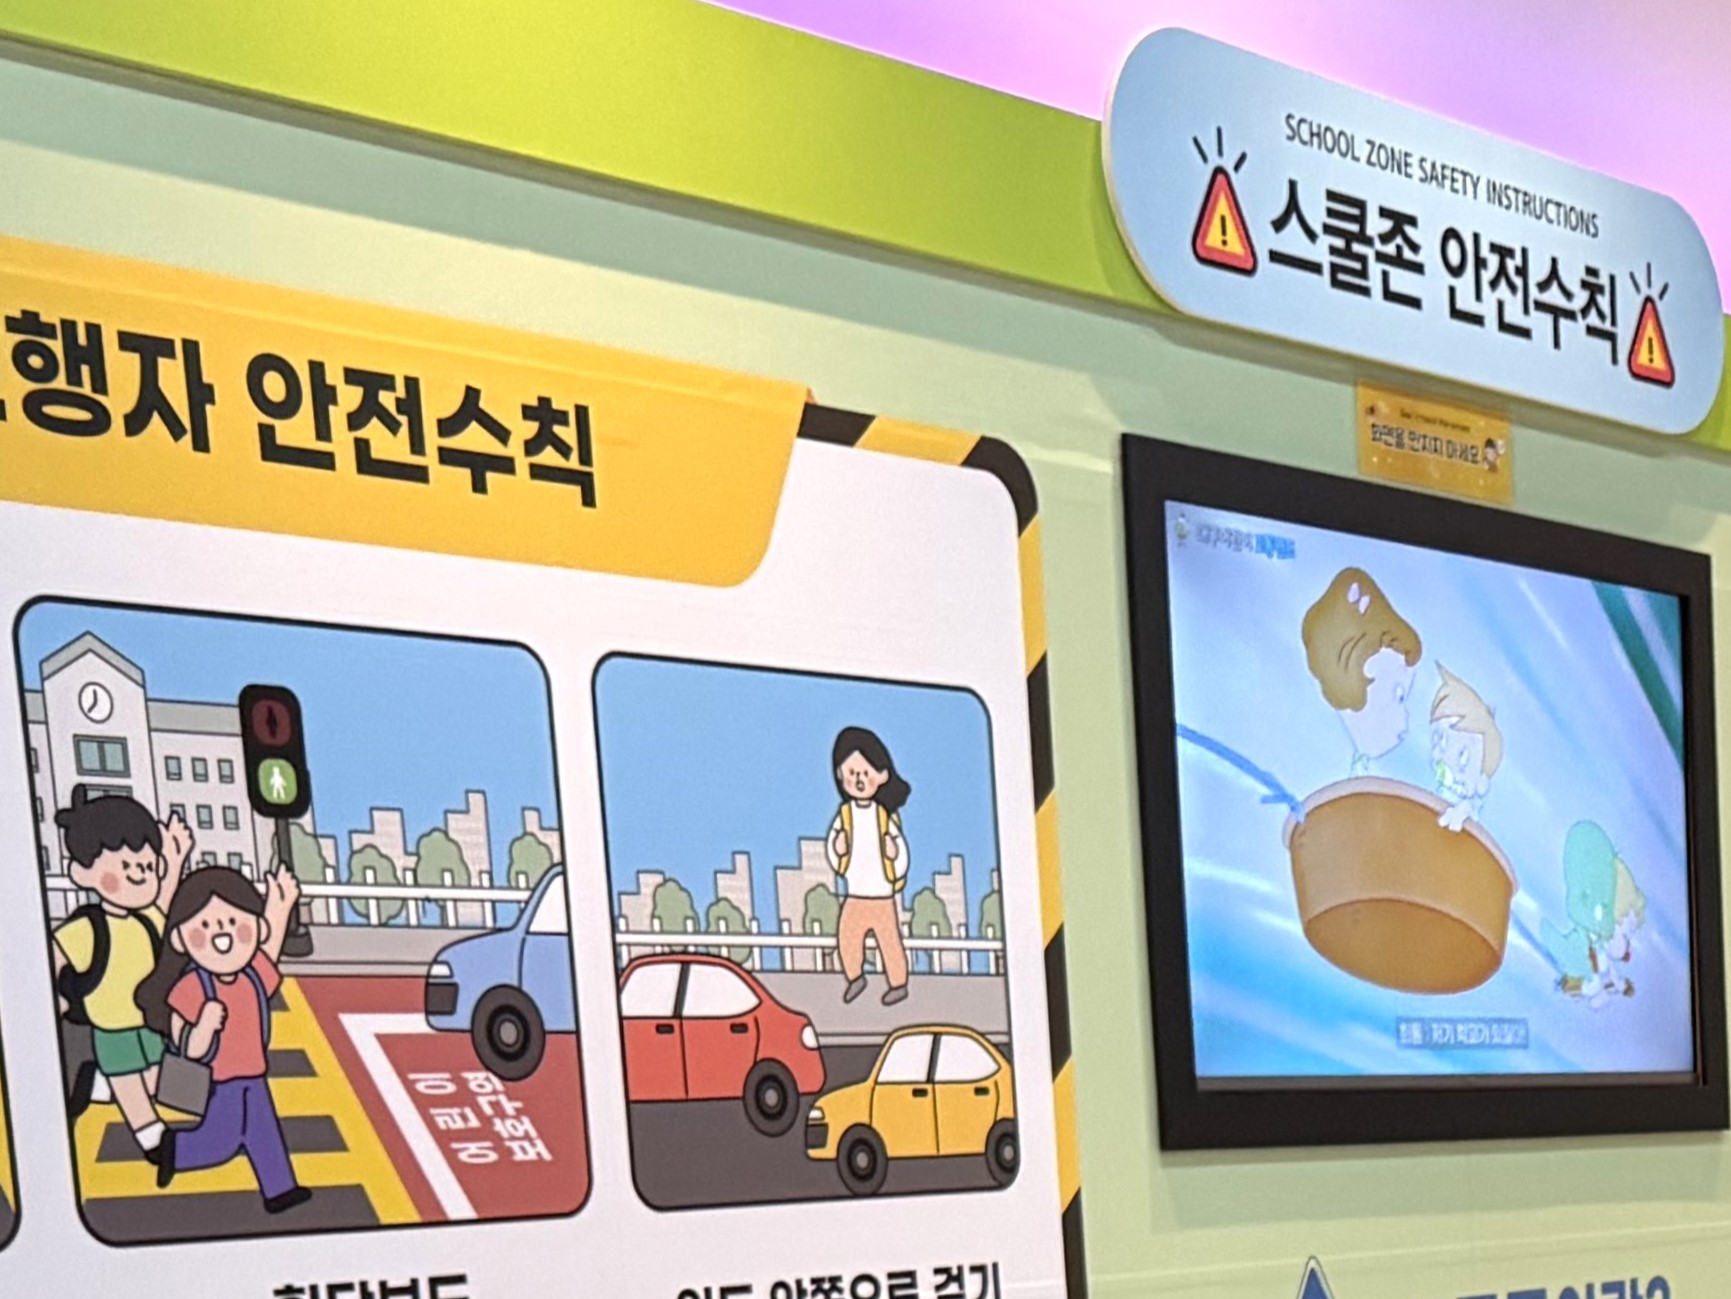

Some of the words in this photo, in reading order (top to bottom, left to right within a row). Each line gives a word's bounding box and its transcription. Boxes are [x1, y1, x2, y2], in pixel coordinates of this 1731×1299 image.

[1285, 112, 1360, 164] SCHOOL
[1365, 138, 1414, 179] ZONE
[1418, 156, 1481, 202] SAFETY
[1486, 178, 1600, 239] INSTRUCTIONS
[1268, 179, 1426, 311] 스쿨존
[1440, 227, 1620, 368] 안전수칙
[0, 309, 216, 454] 행자
[245, 352, 598, 509] 안전수칙
[407, 1072, 500, 1165] 어린이
[460, 1070, 553, 1162] 보호구역
